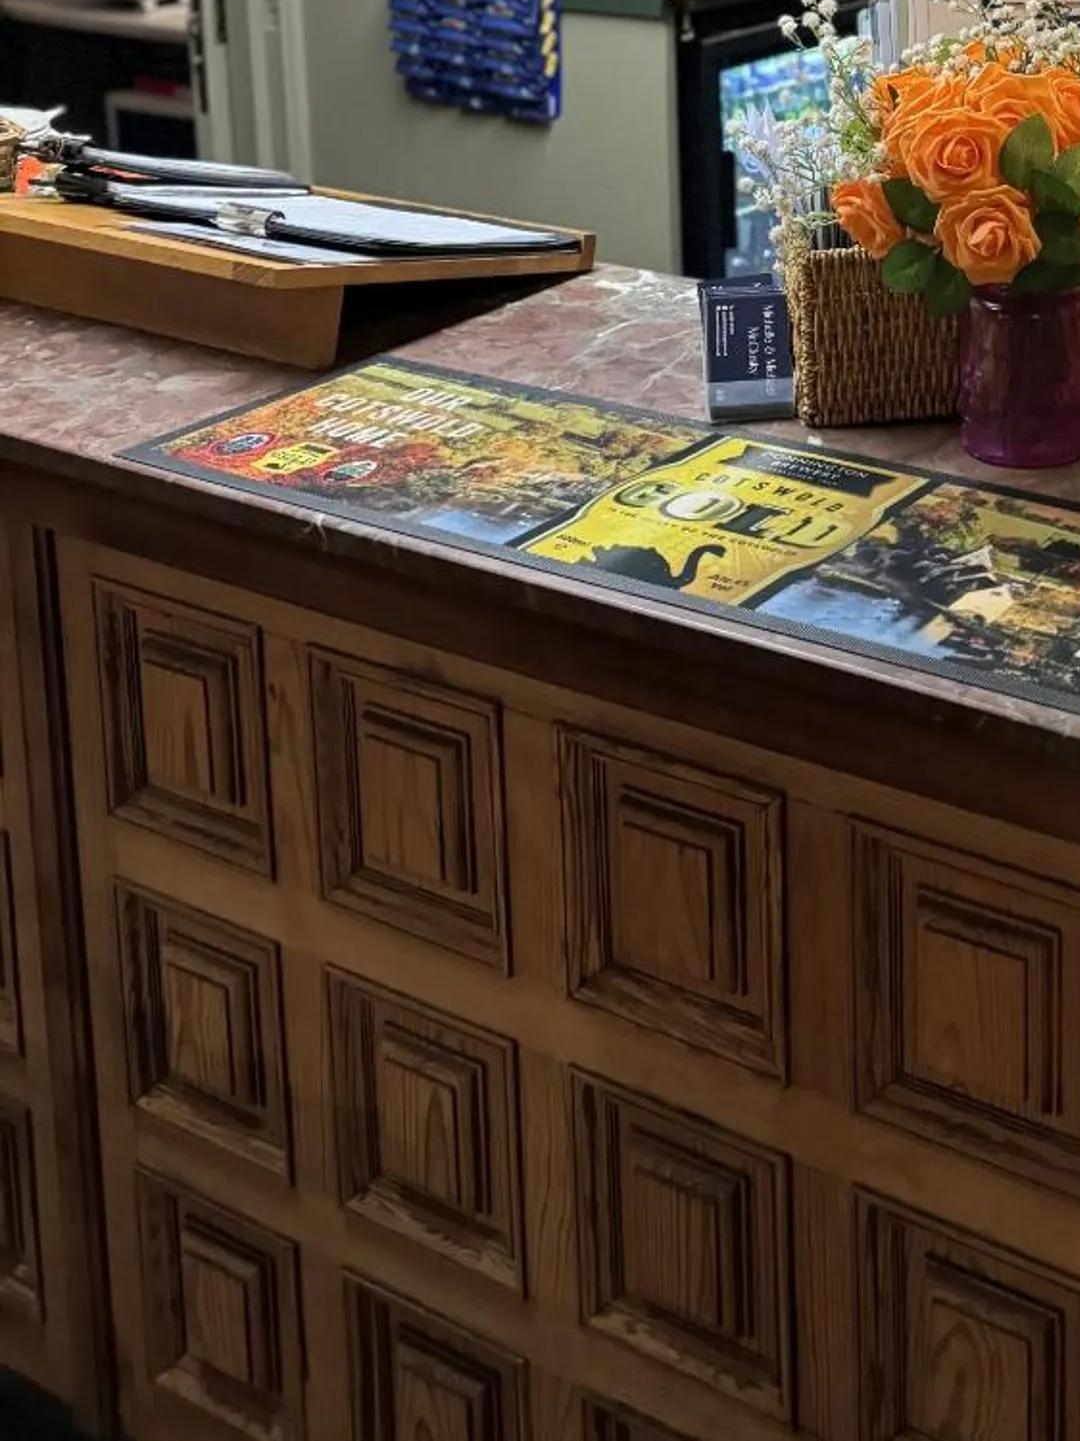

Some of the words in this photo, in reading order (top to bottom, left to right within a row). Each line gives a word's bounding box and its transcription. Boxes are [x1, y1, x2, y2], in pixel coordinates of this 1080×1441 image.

[314, 393, 486, 439] COTSWOLD
[401, 387, 473, 411] OUR
[307, 415, 409, 449] HOME
[695, 472, 844, 513] COTSWOLD
[613, 479, 853, 550] GOLD
